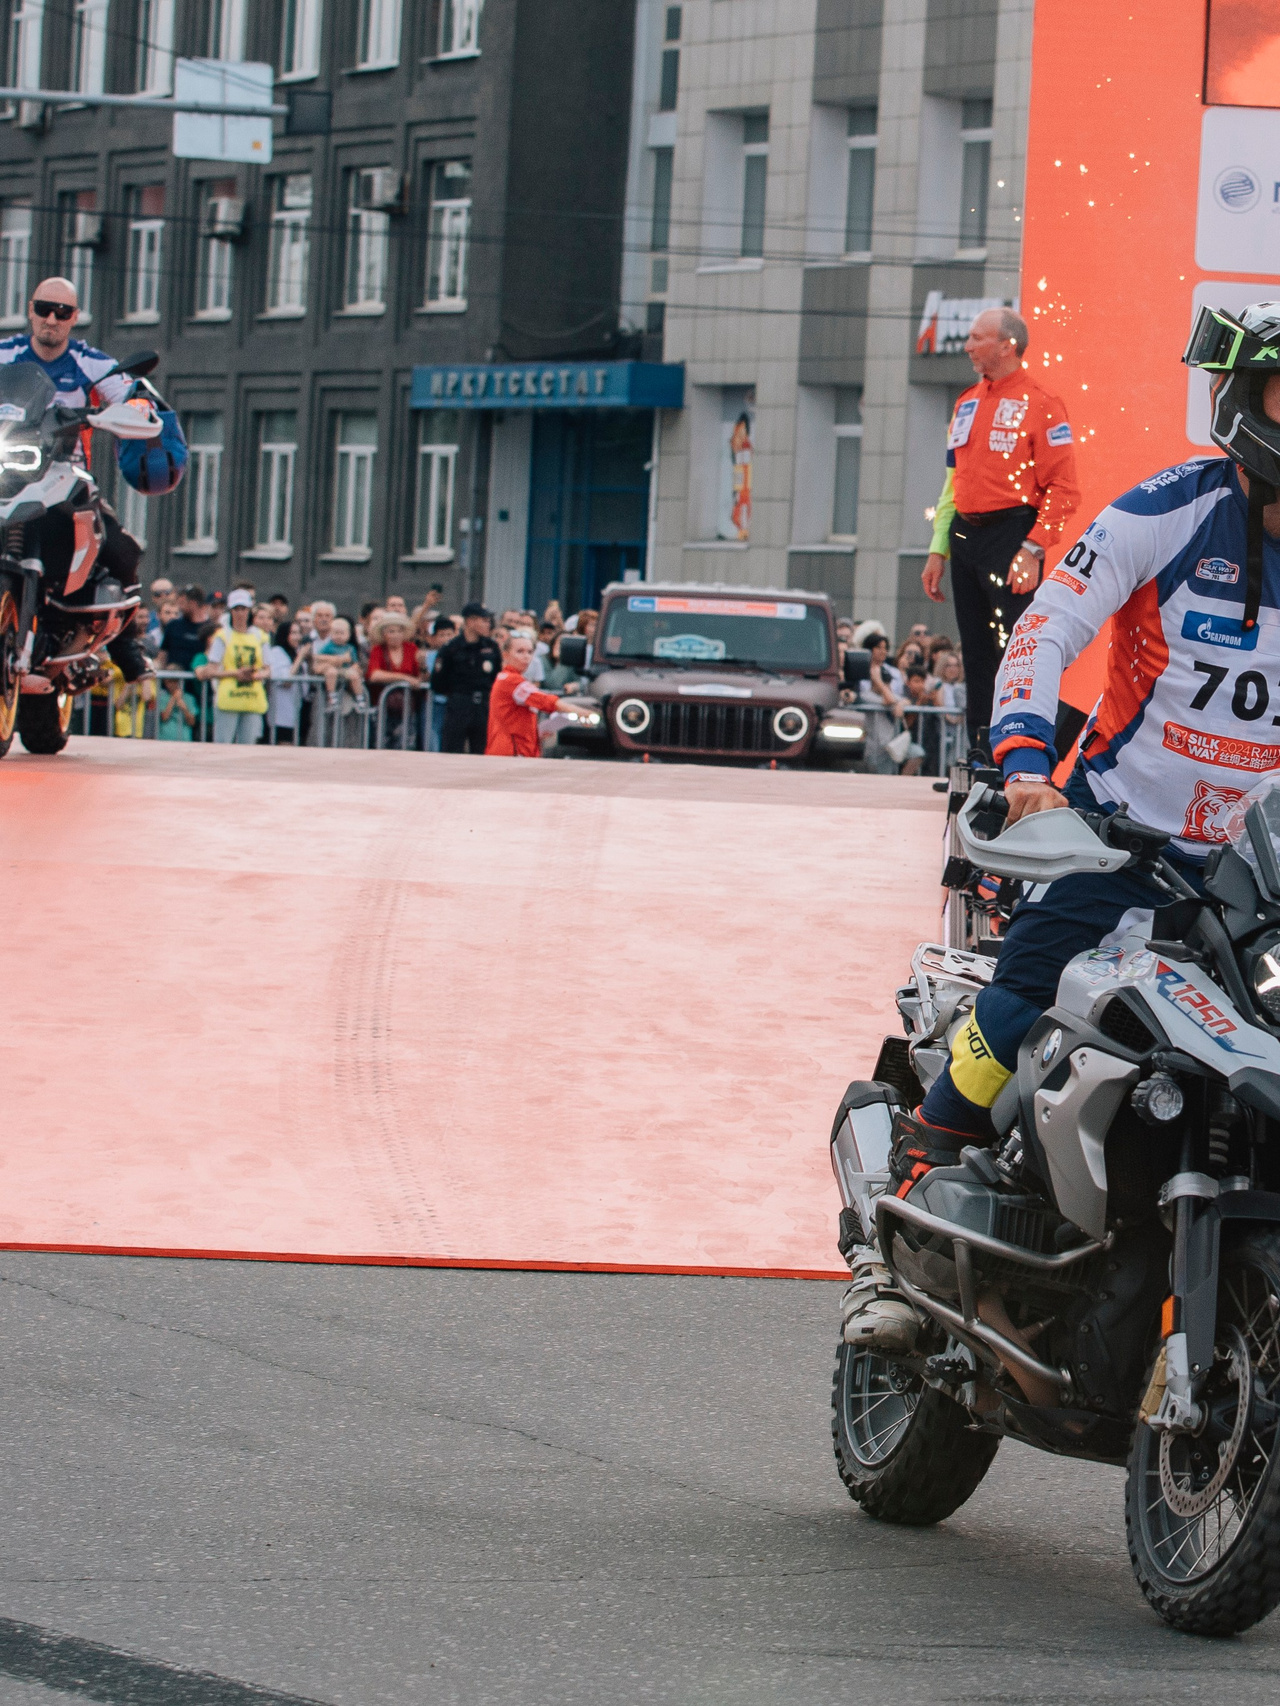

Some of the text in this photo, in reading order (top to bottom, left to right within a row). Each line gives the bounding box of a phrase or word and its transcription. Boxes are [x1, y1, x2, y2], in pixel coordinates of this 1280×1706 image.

[1209, 631, 1242, 647] GAZPROM
[1007, 645, 1037, 662] WAY
[1004, 657, 1036, 672] RALLY
[1187, 744, 1219, 761] WAY
[1188, 733, 1220, 750] SILK
[1221, 741, 1250, 755] 2024
